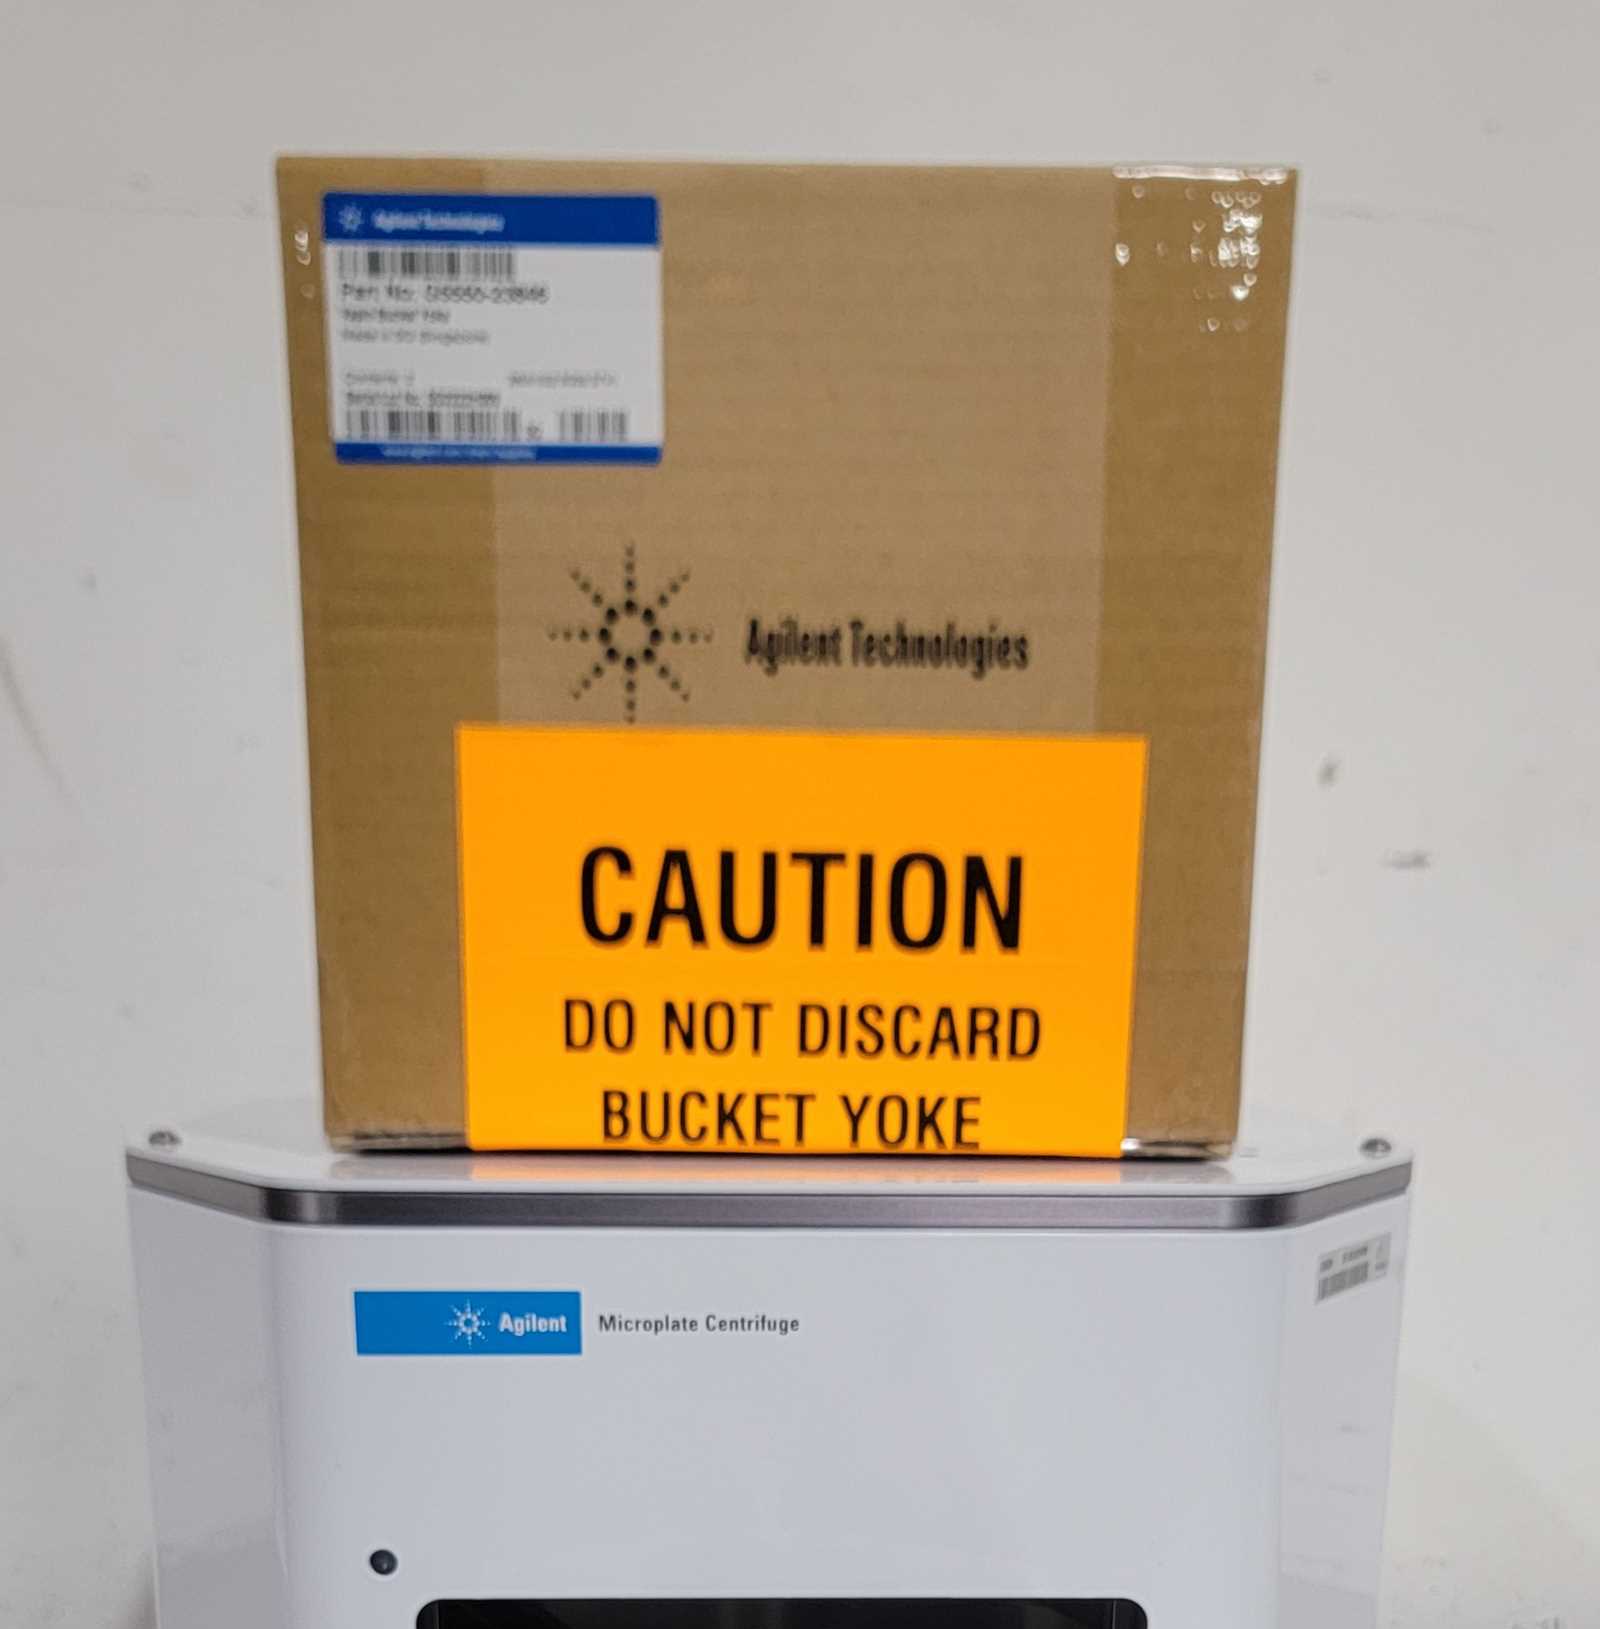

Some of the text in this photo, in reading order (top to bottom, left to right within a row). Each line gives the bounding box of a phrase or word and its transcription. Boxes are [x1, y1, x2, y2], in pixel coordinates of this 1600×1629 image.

[746, 616, 1030, 680] Agilent Technologies
[579, 845, 1023, 952] CAUTION
[563, 997, 1042, 1061] DO NOT DISCARD
[601, 1089, 983, 1151] BUCKET YOKE
[499, 1312, 801, 1338] Agilent Microplate Centrifuge
